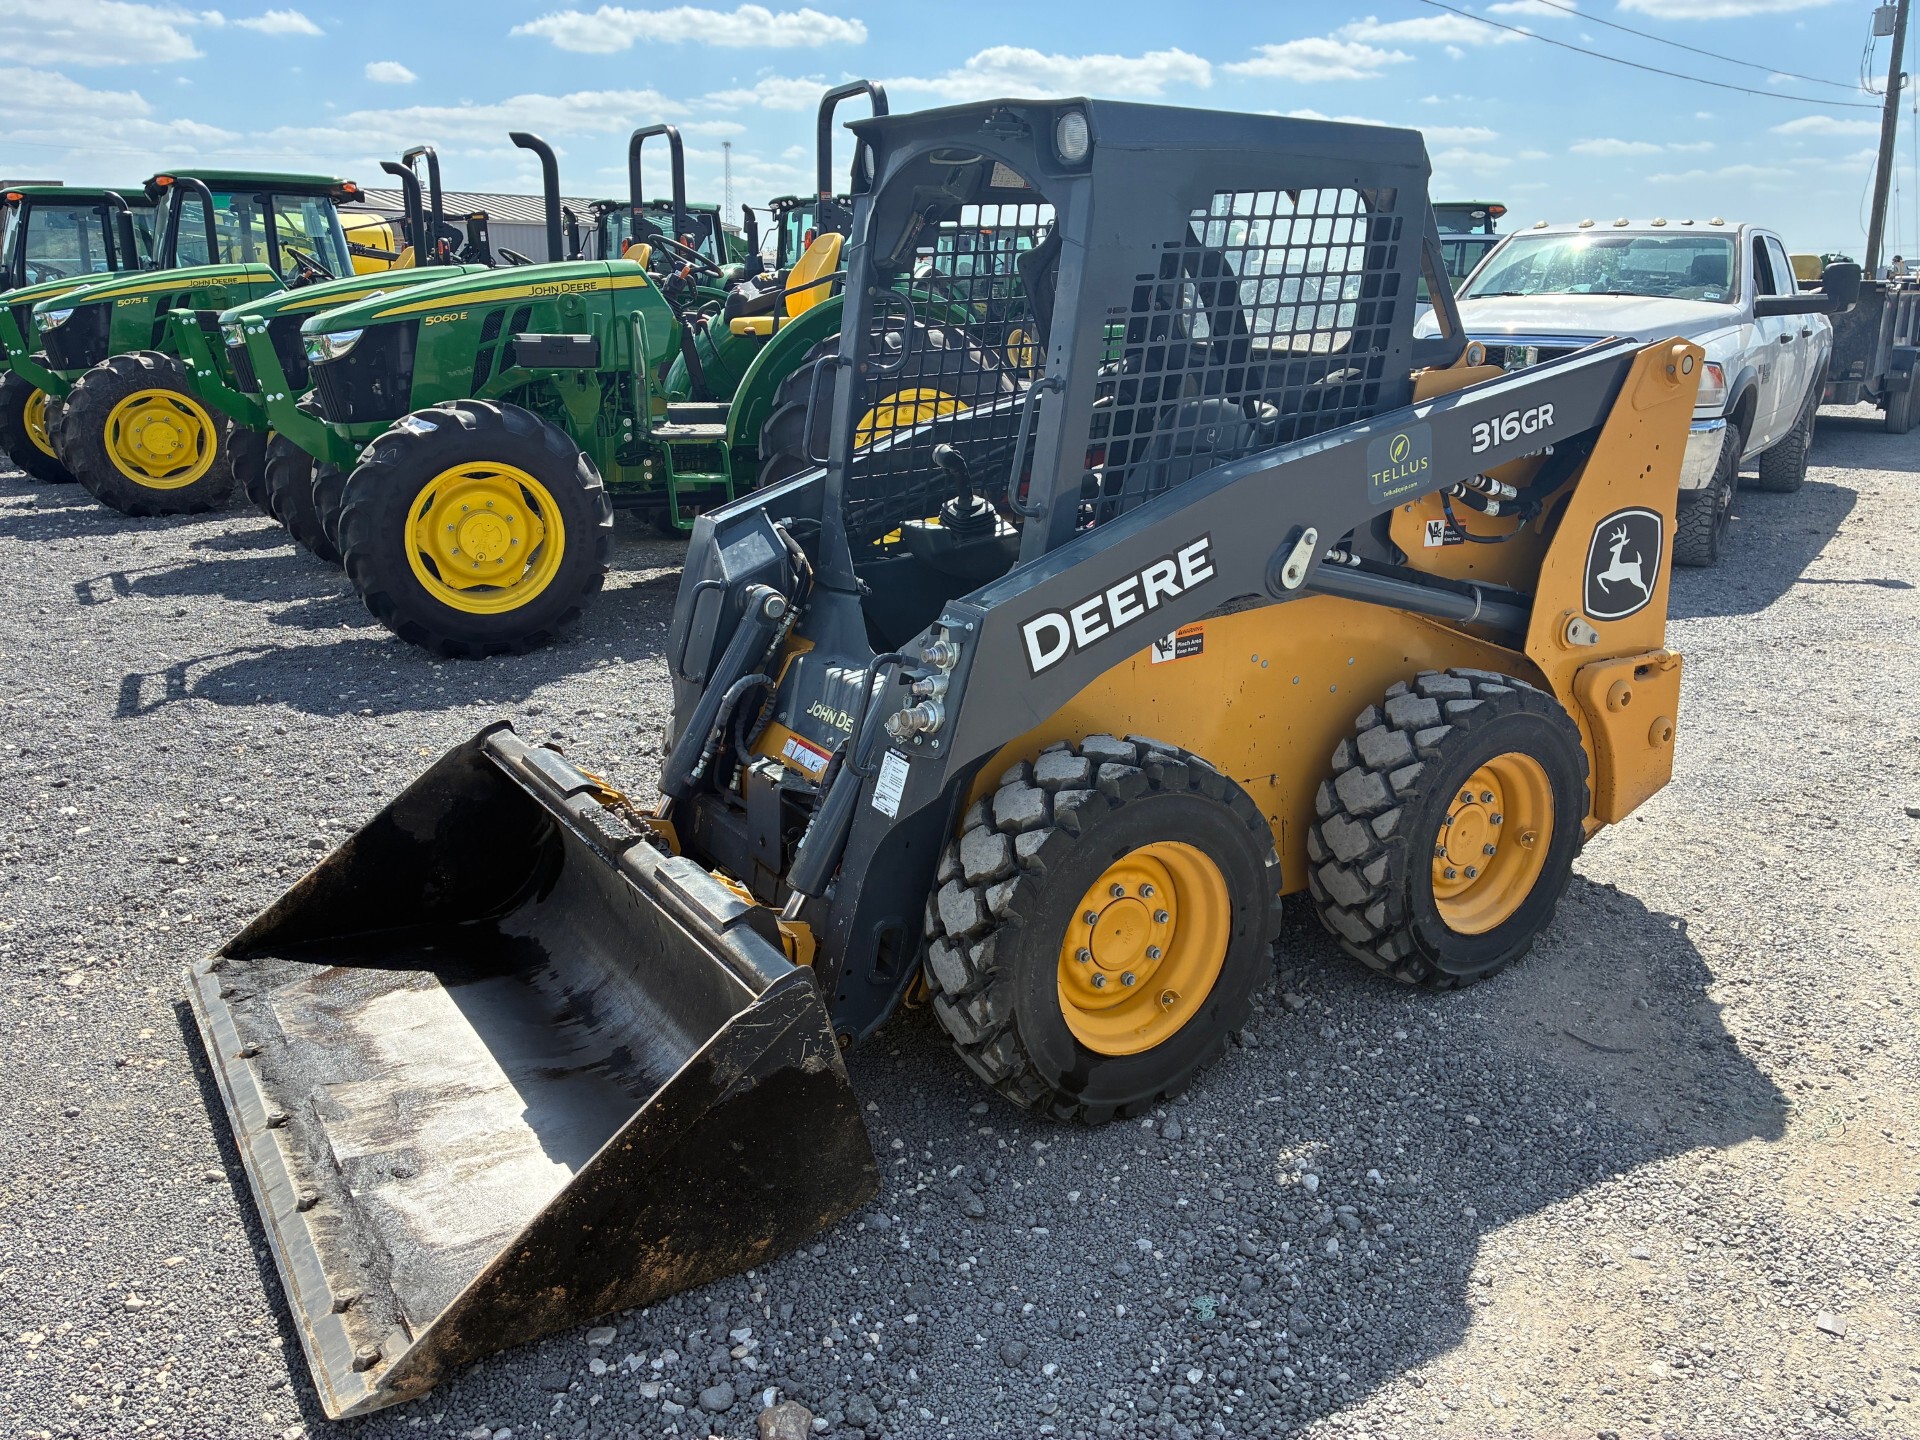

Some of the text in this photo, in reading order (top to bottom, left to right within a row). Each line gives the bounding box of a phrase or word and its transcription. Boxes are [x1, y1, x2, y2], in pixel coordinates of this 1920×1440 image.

[211, 277, 238, 285] DEERE
[528, 282, 597, 296] JOHN DEERE
[117, 298, 142, 307] 5075
[425, 311, 468, 326] 5060 E
[1472, 403, 1555, 453] 316GR
[1371, 456, 1428, 486] TELLUS
[1023, 537, 1214, 673] DEERE
[1177, 640, 1190, 648] Pinch
[806, 700, 837, 724] JOHN
